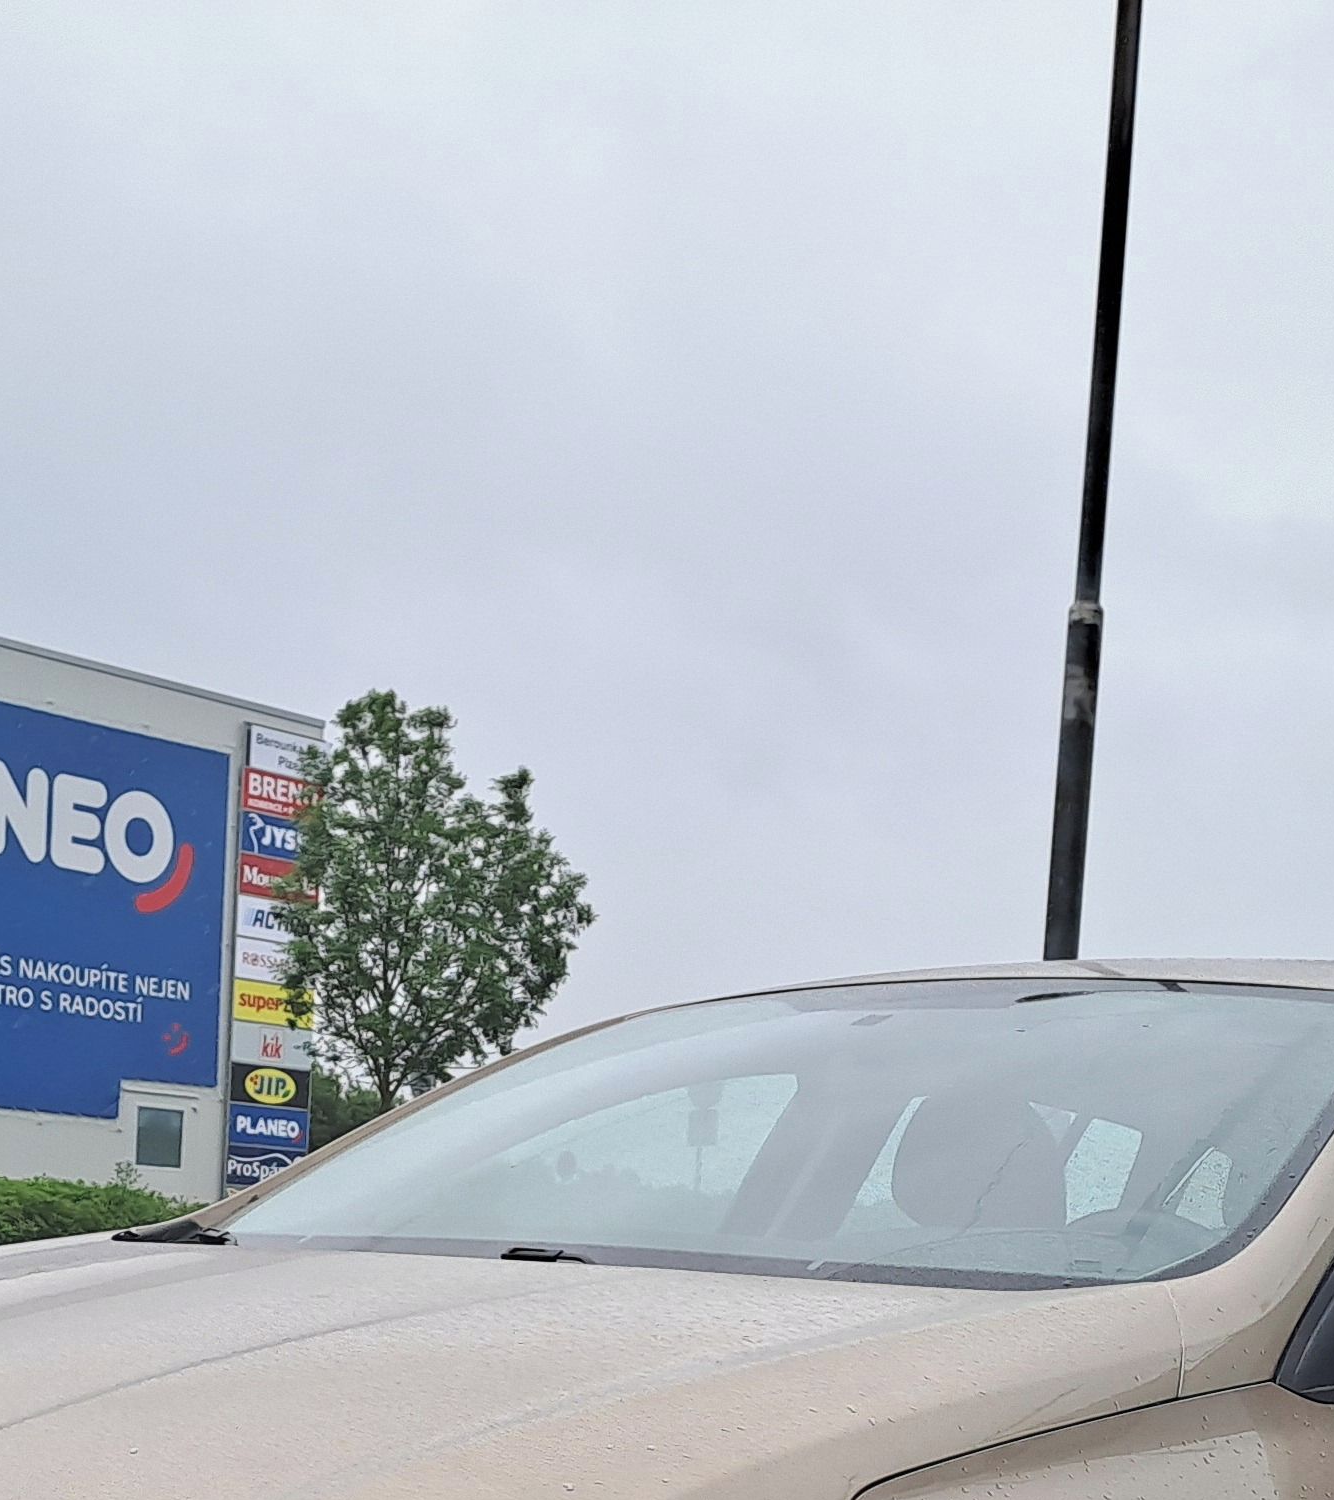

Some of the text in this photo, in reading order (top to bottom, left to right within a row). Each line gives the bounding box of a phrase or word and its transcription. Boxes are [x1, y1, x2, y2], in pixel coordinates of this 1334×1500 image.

[242, 952, 285, 969] ROSS
[19, 958, 129, 993] NAKOUPÍTE
[135, 975, 191, 1000] NEJEN
[40, 990, 53, 1011] S
[59, 995, 143, 1022] RADOSTÍ
[238, 992, 291, 1013] super
[261, 1032, 283, 1060] kik
[255, 1074, 287, 1097] JIP
[236, 1115, 300, 1139] PLANEO
[227, 1159, 288, 1181] ProSpá
